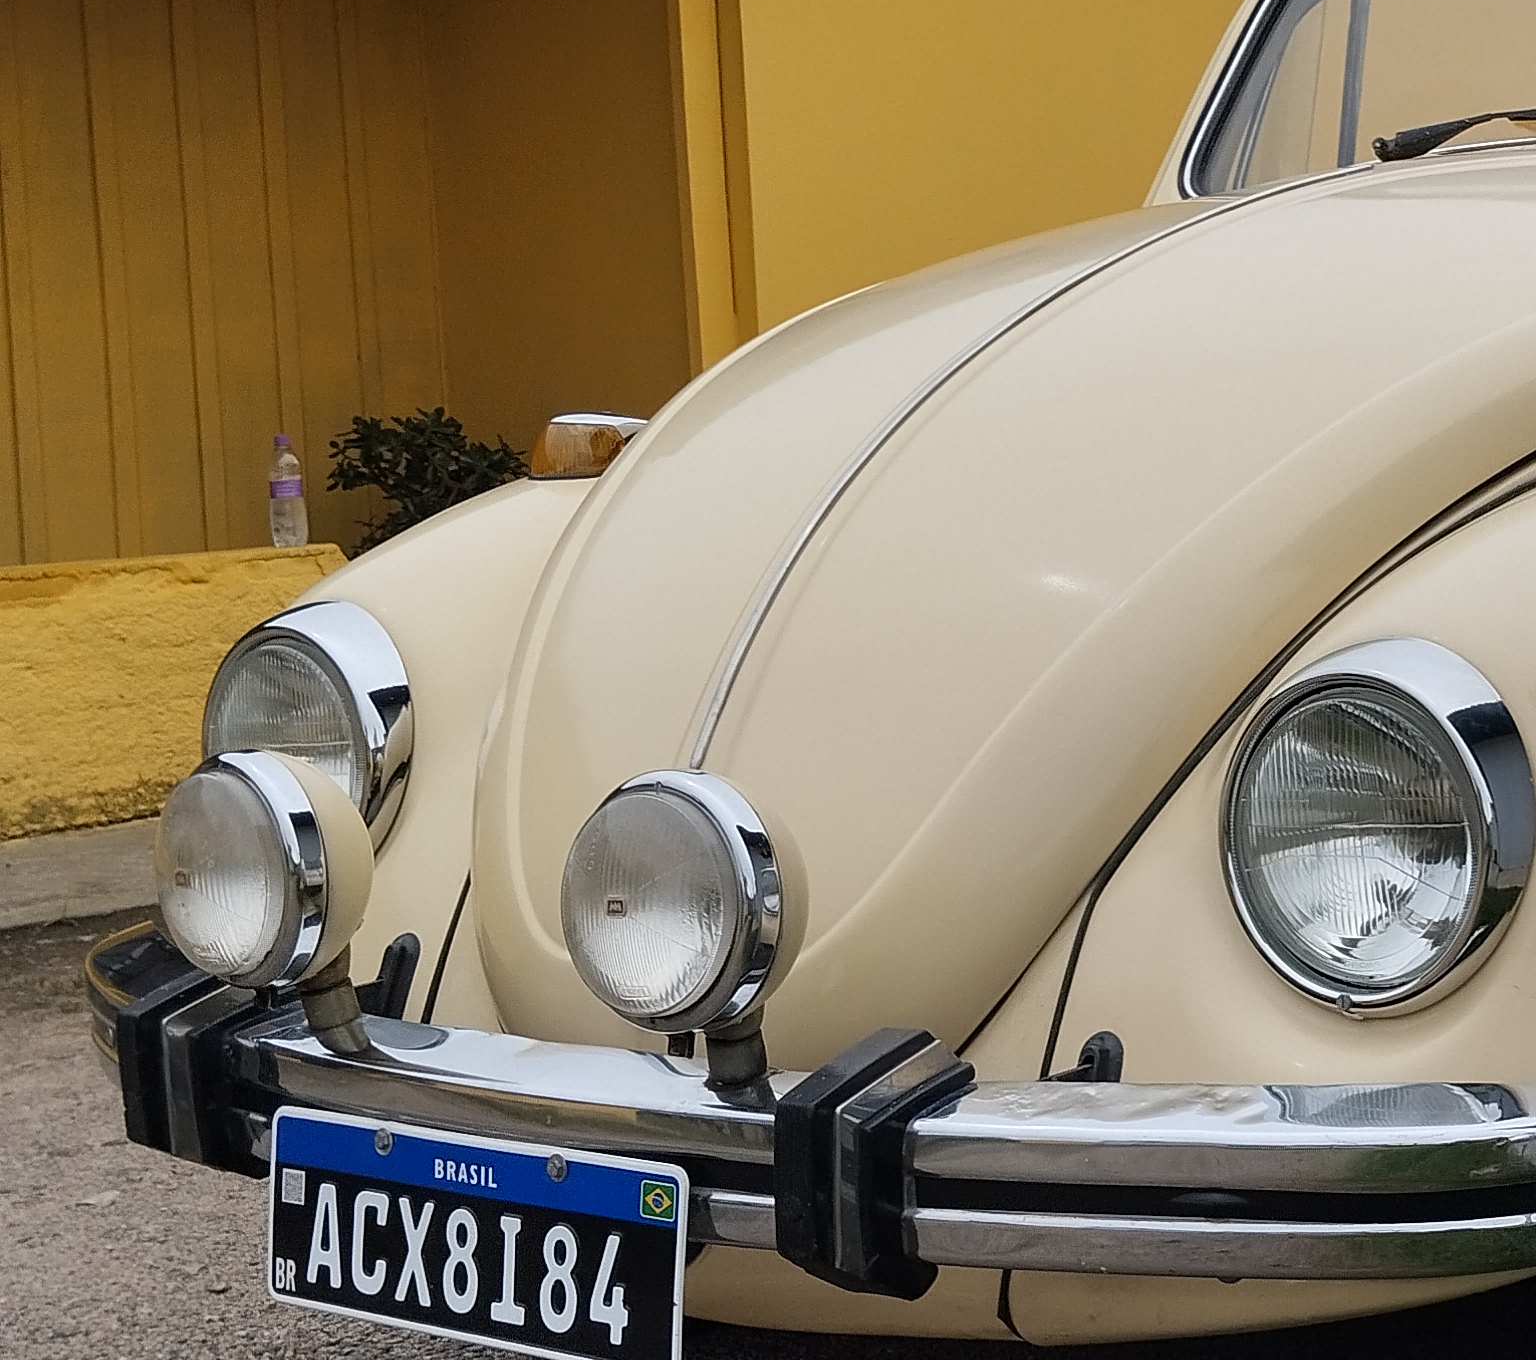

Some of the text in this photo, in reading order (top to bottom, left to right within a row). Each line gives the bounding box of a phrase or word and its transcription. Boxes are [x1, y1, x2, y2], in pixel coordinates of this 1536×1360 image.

[433, 1158, 498, 1189] BRASIL
[275, 1256, 296, 1292] BR
[306, 1183, 629, 1345] ACX8I84
